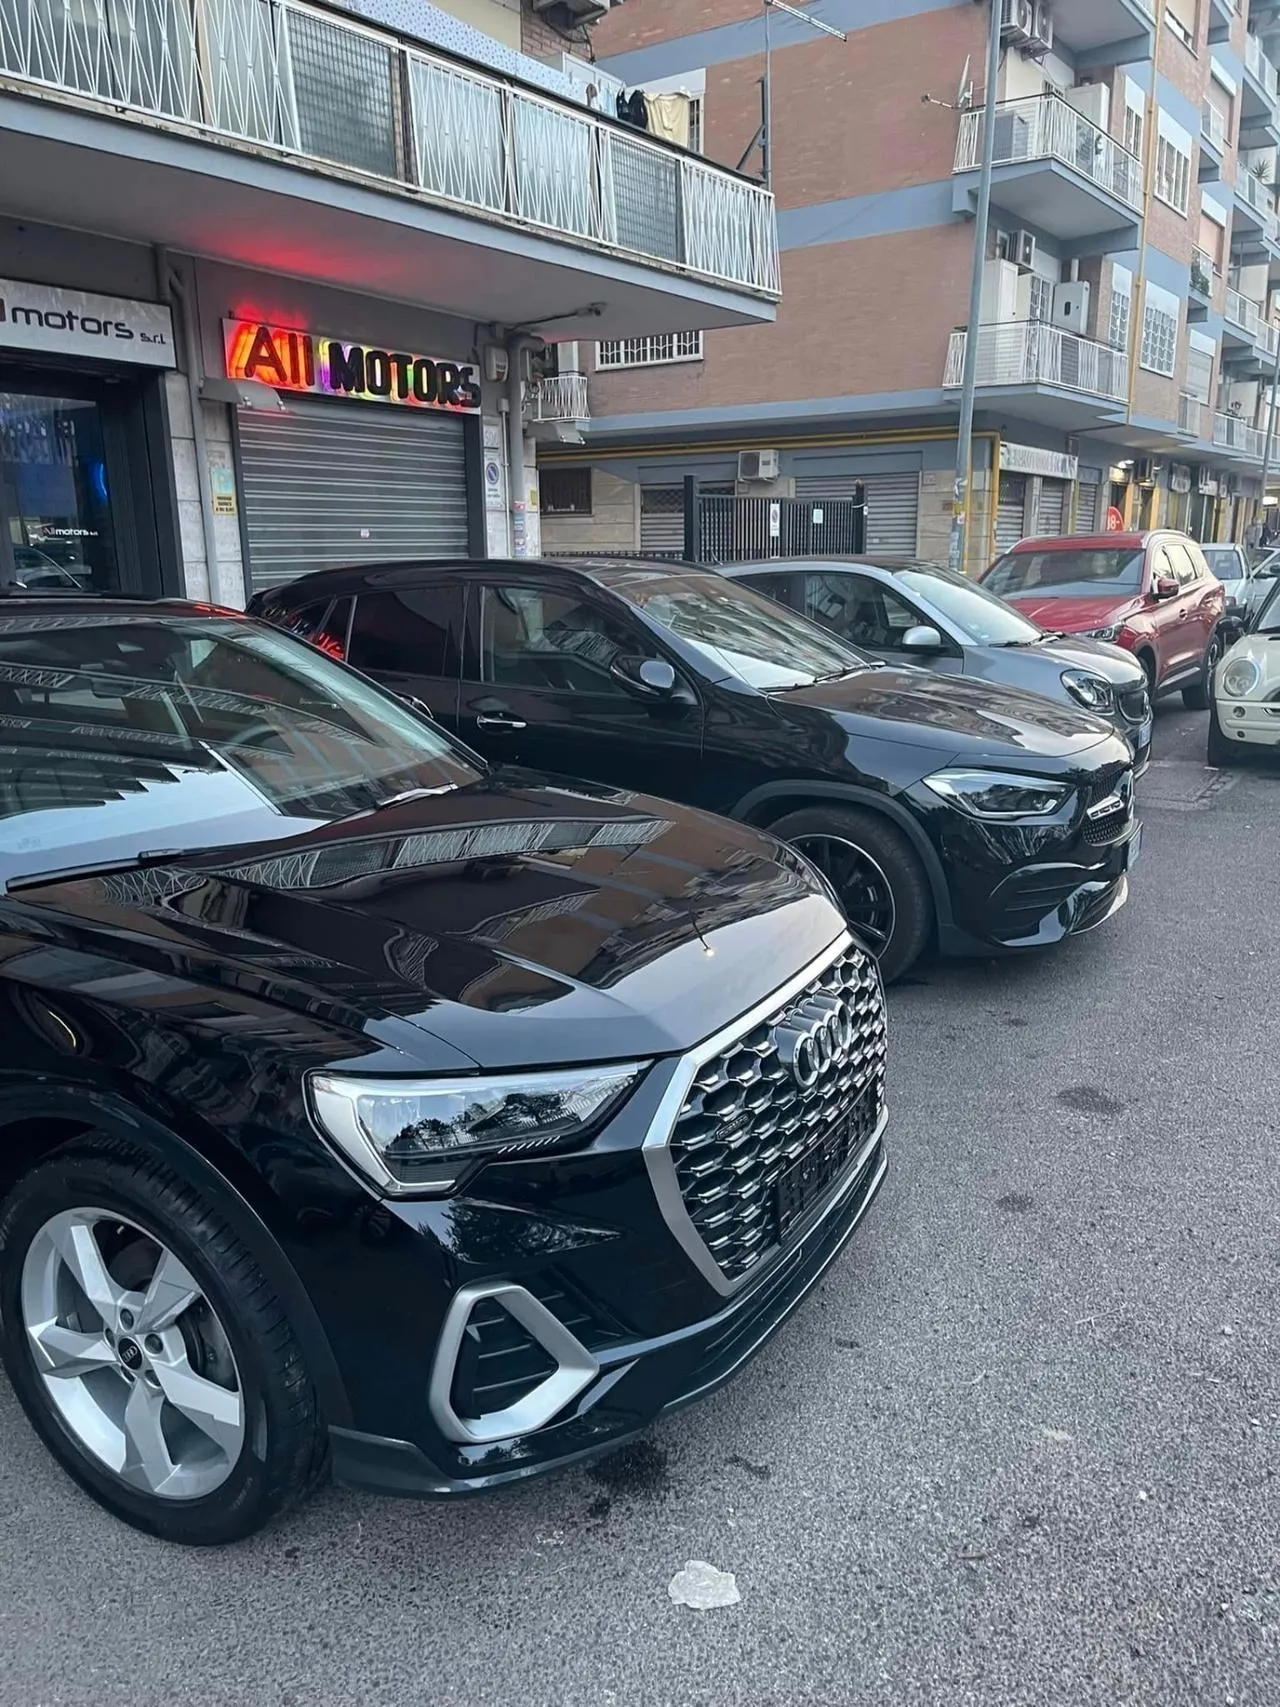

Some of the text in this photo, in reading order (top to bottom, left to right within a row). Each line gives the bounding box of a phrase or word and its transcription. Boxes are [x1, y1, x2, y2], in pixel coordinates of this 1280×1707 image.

[11, 307, 134, 340] motors
[245, 326, 481, 407] All MOTORS
